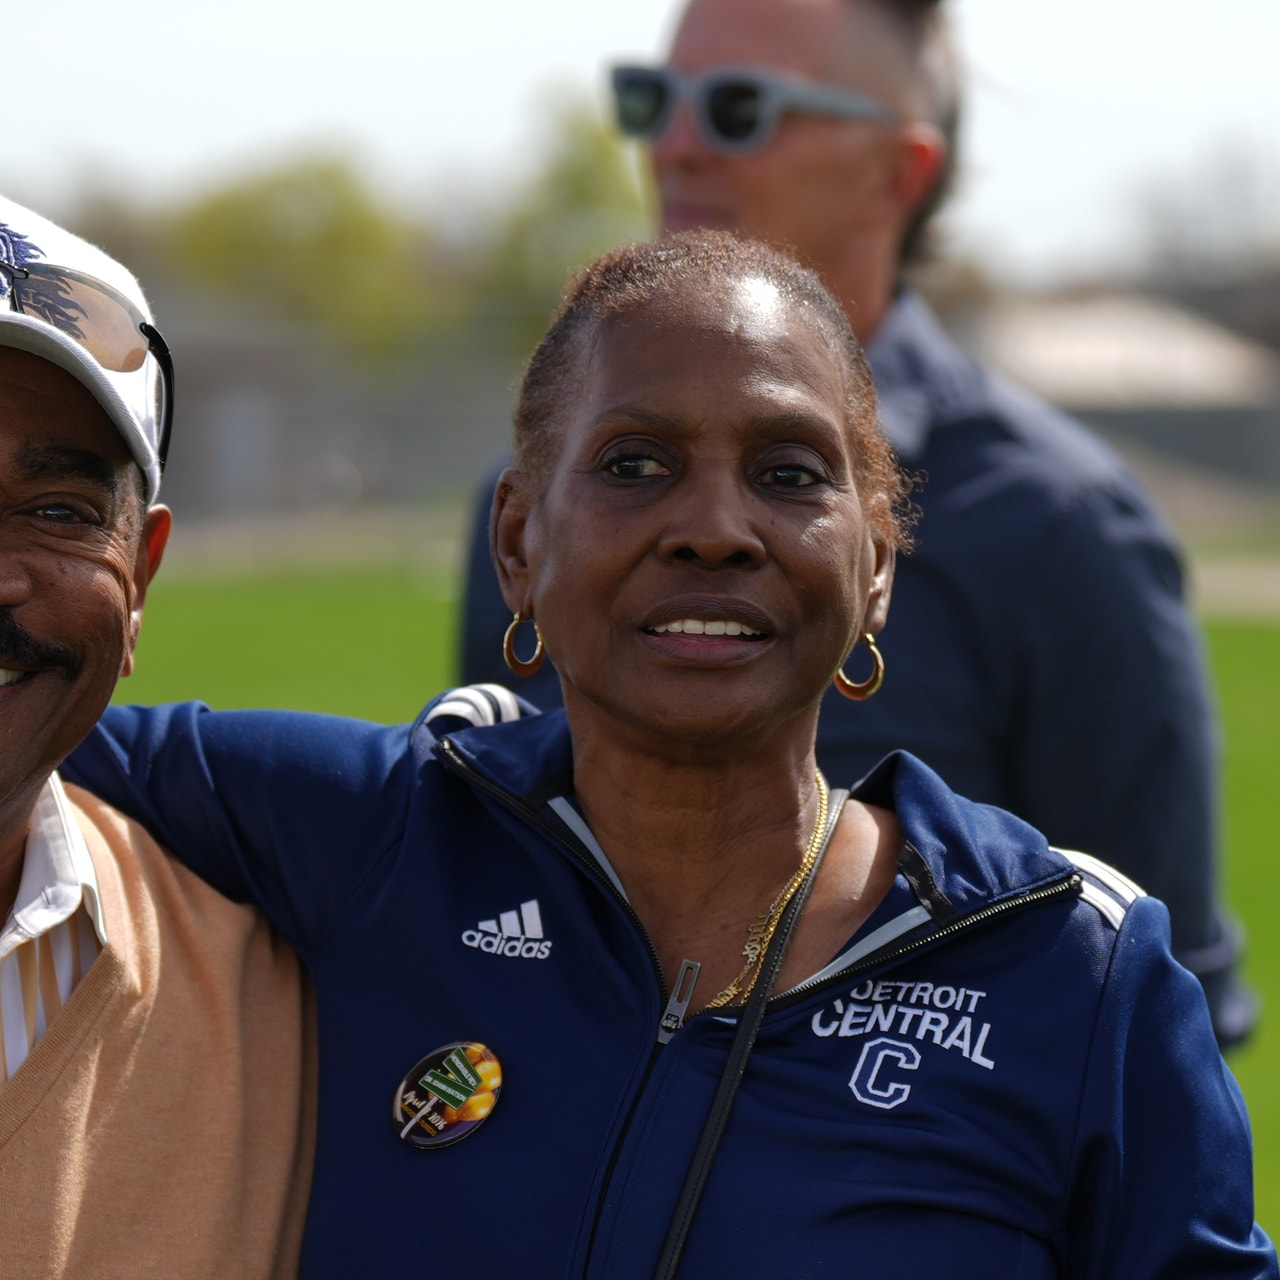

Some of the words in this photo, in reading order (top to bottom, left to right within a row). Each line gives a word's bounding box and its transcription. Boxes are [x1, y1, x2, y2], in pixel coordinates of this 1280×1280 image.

[461, 929, 552, 959] adidas
[811, 998, 995, 1070] CENTRAL
[848, 1036, 922, 1110] C
[402, 1090, 427, 1109] April
